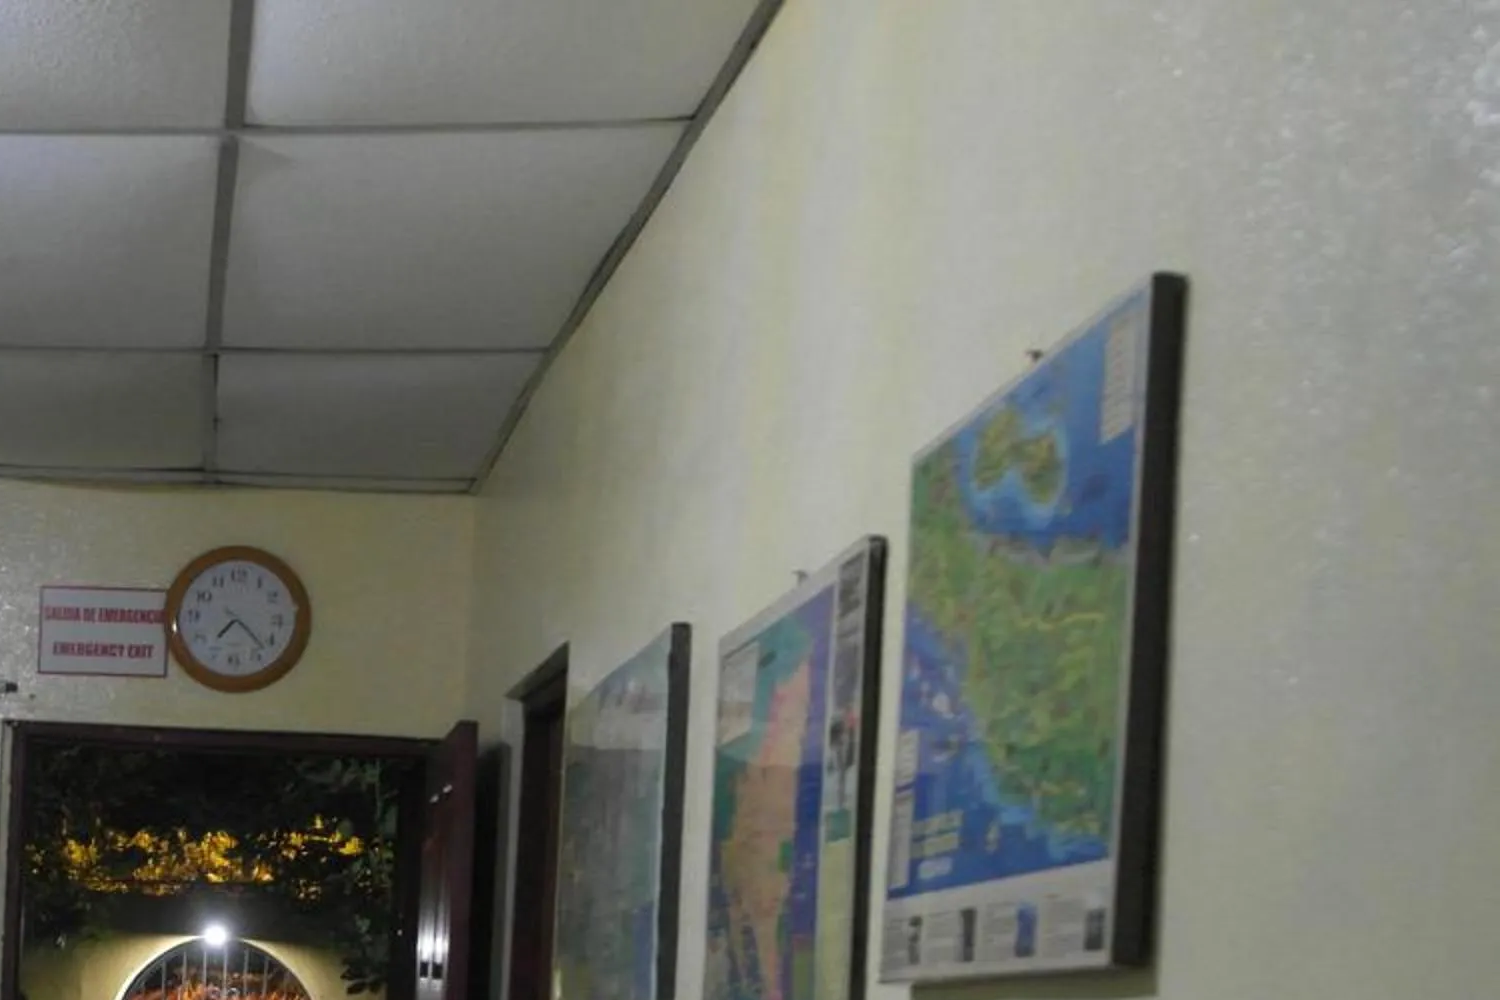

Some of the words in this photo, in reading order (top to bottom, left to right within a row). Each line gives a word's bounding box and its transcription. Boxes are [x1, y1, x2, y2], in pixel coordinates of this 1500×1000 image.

[44, 605, 80, 621] SALIDA
[83, 607, 95, 623] DE
[53, 641, 124, 657] EMERGENCY
[128, 643, 154, 659] EXIT
